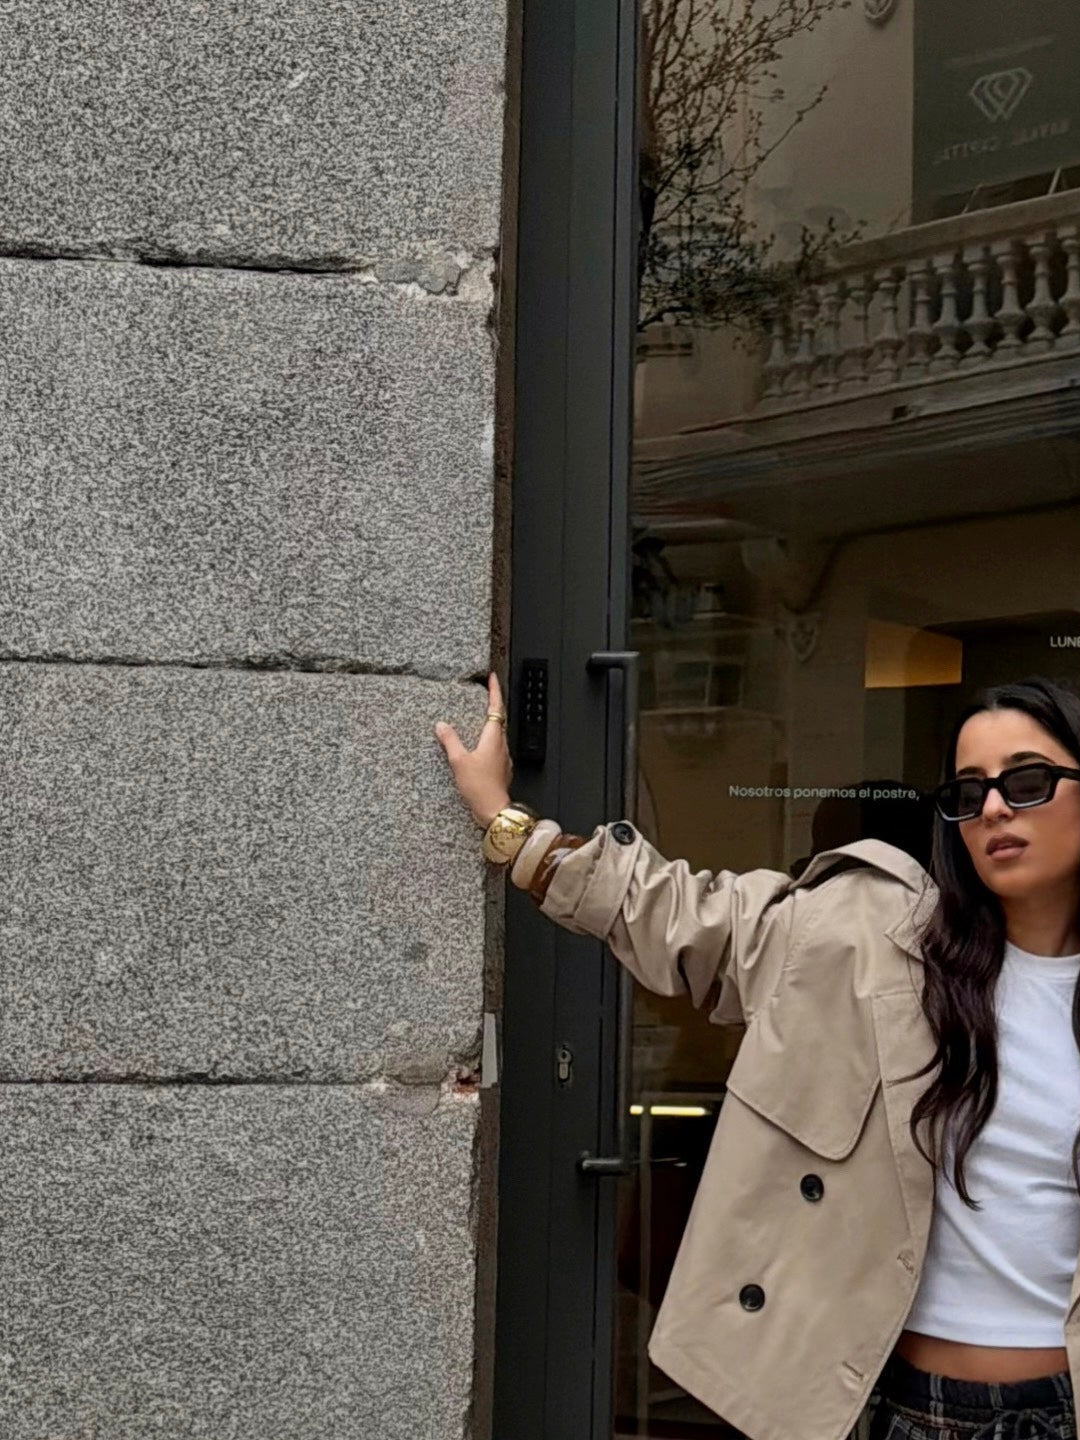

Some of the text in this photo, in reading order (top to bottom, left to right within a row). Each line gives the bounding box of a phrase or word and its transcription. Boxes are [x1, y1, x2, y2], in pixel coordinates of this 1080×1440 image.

[729, 786, 920, 800] Nosotros ponemos el postre,
